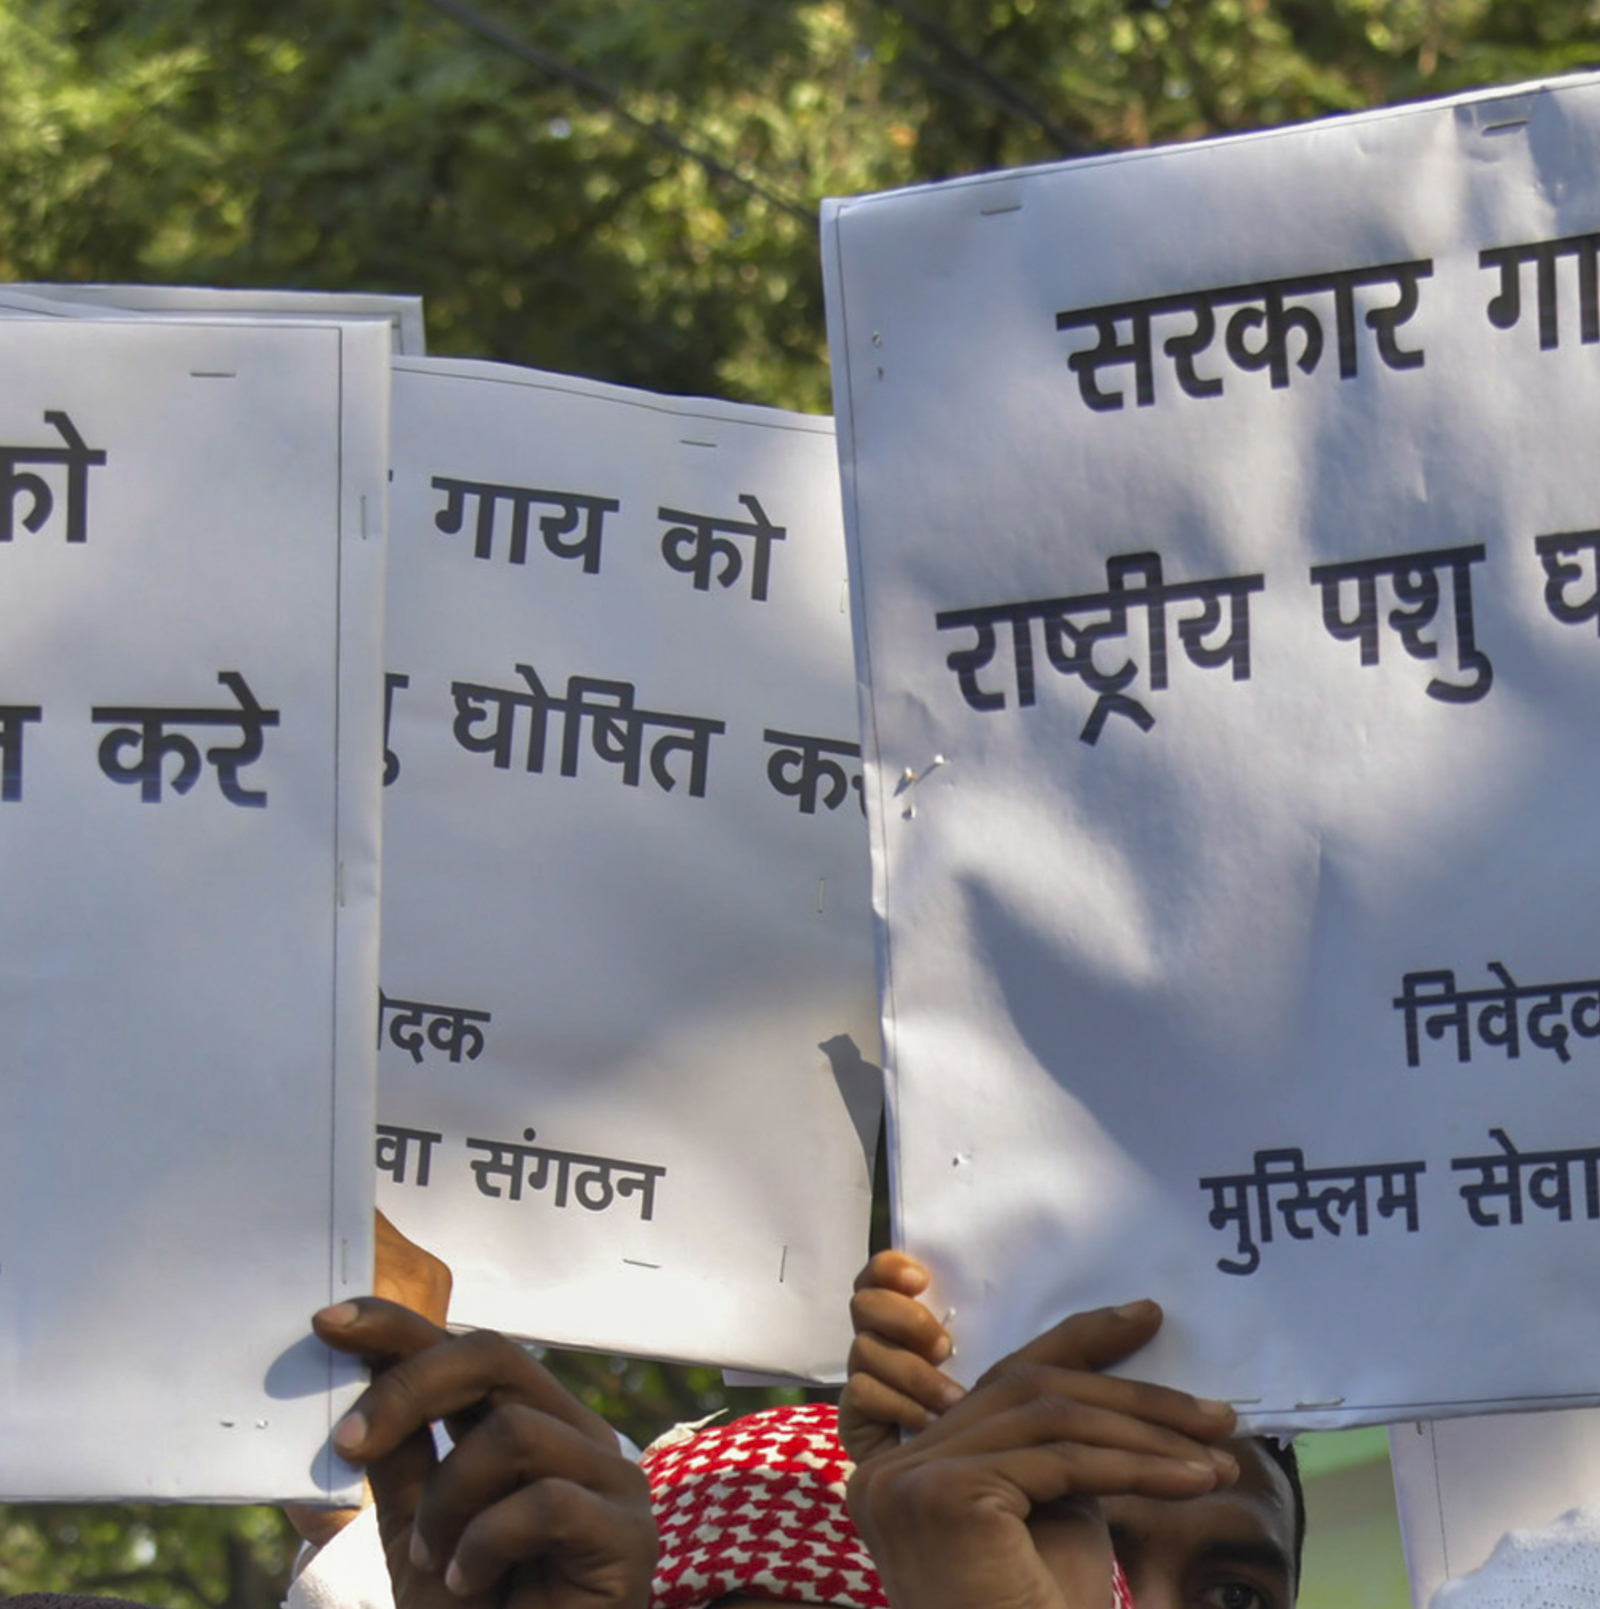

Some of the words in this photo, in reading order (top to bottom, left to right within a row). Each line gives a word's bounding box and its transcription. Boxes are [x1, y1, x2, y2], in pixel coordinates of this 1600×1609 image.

[1057, 257, 1434, 412] सरकार
[431, 476, 620, 574] गाय
[658, 494, 786, 601] को
[936, 550, 1265, 747] राष्ट्रीय
[1310, 543, 1494, 704] पशु
[91, 671, 280, 808] करे
[451, 663, 725, 798] घोषित
[466, 1128, 666, 1221] संगठन
[1200, 1148, 1426, 1275] मुस्लिम
